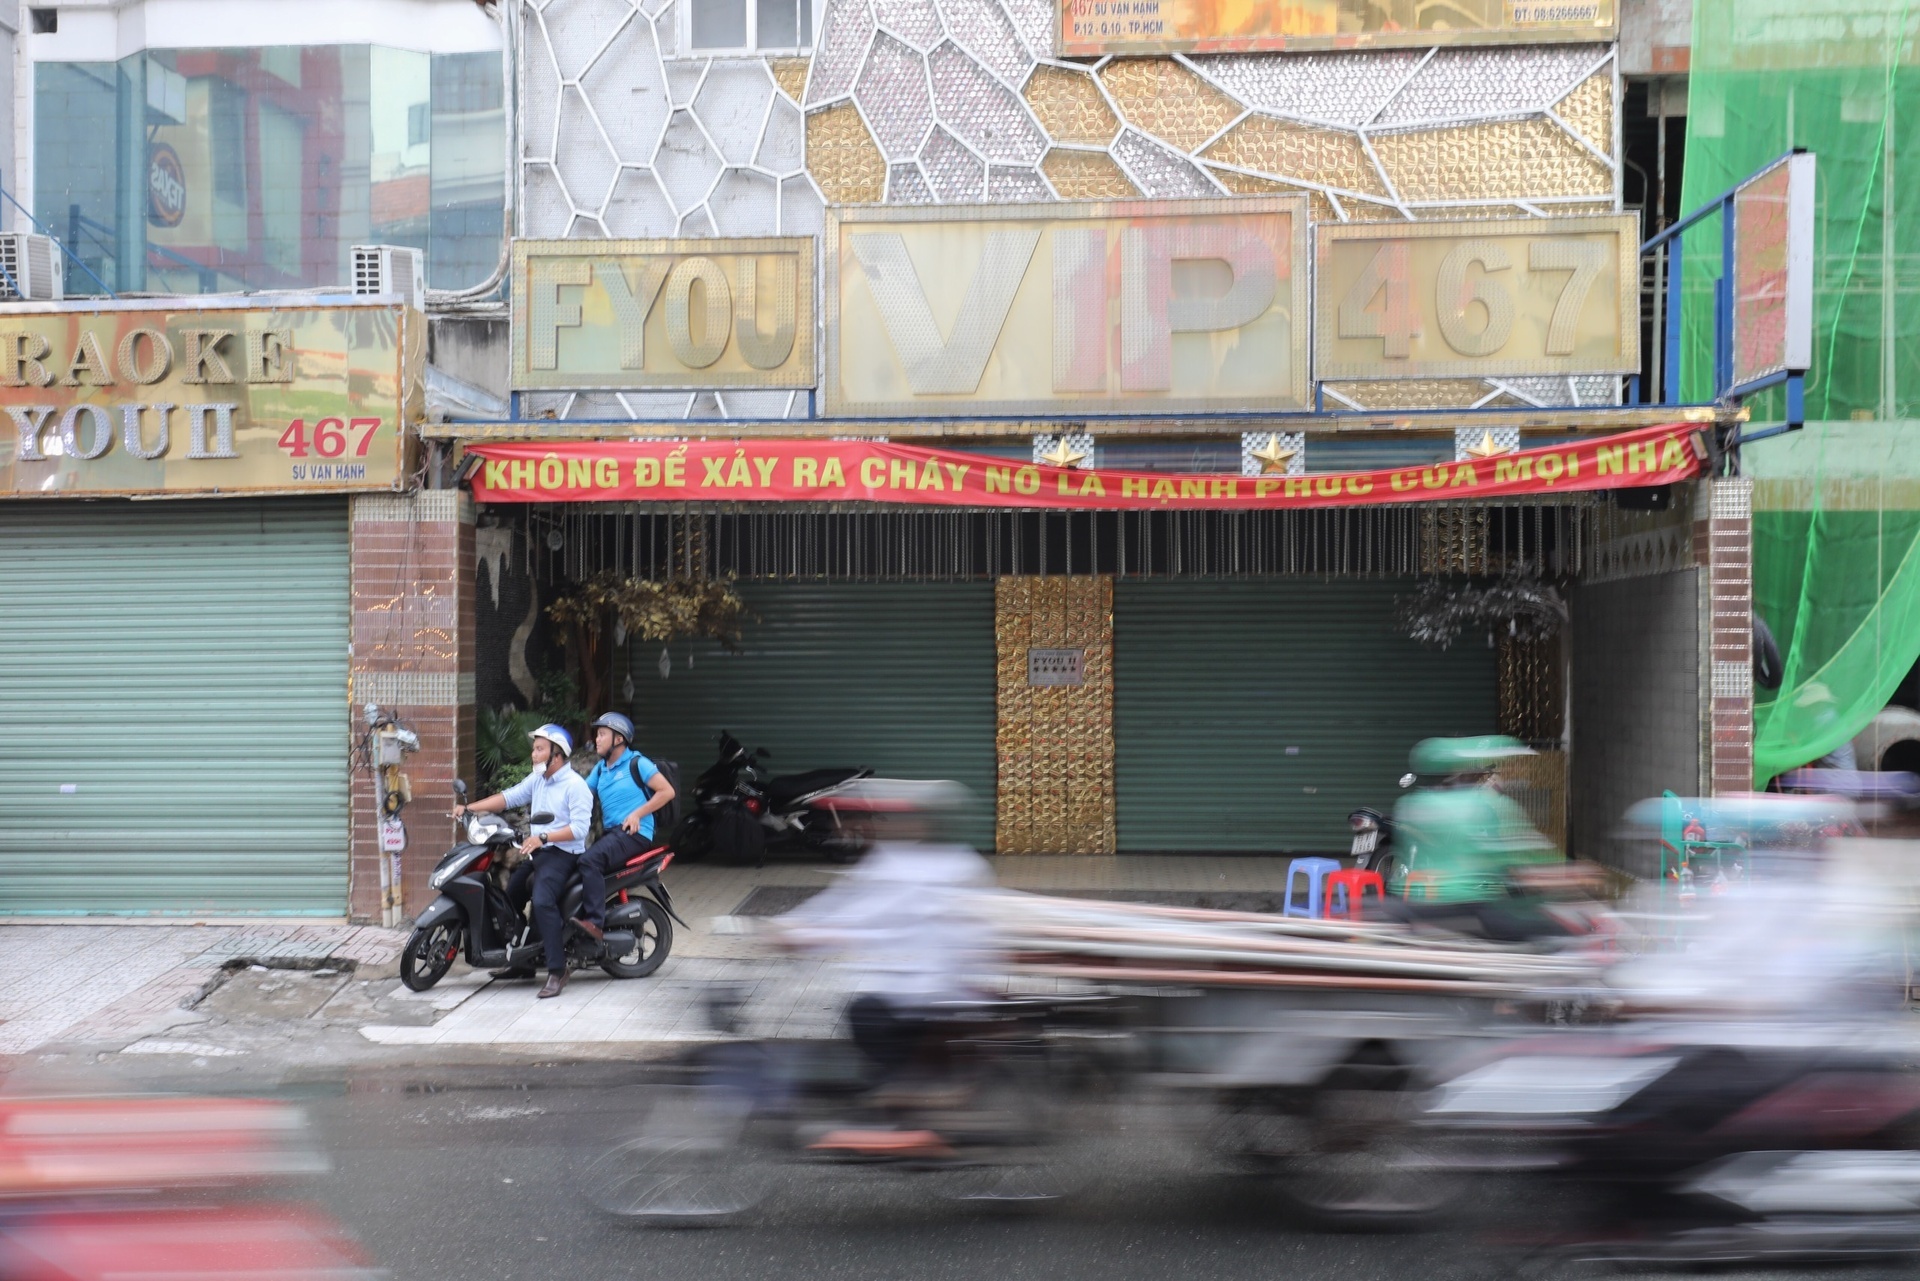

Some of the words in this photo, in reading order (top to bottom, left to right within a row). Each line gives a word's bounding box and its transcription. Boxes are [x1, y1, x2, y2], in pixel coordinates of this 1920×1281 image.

[1129, 20, 1163, 34] TP.HCM
[532, 256, 797, 370] FYOU
[848, 227, 1277, 395] VIP
[1338, 239, 1611, 358] 467
[0, 328, 294, 388] RAOKE
[278, 417, 382, 458] 467
[485, 452, 620, 490] KHÔNG
[633, 444, 687, 488] ĐỂ
[700, 448, 778, 488] XẢY
[793, 457, 846, 488] RA
[860, 456, 970, 492] CHÁY
[1122, 477, 1237, 504] HẠNH
[1494, 452, 1579, 486] MỌI
[1597, 433, 1687, 476] NHÀ
[310, 466, 332, 484] VẠN
[336, 465, 365, 484] HẠNH
